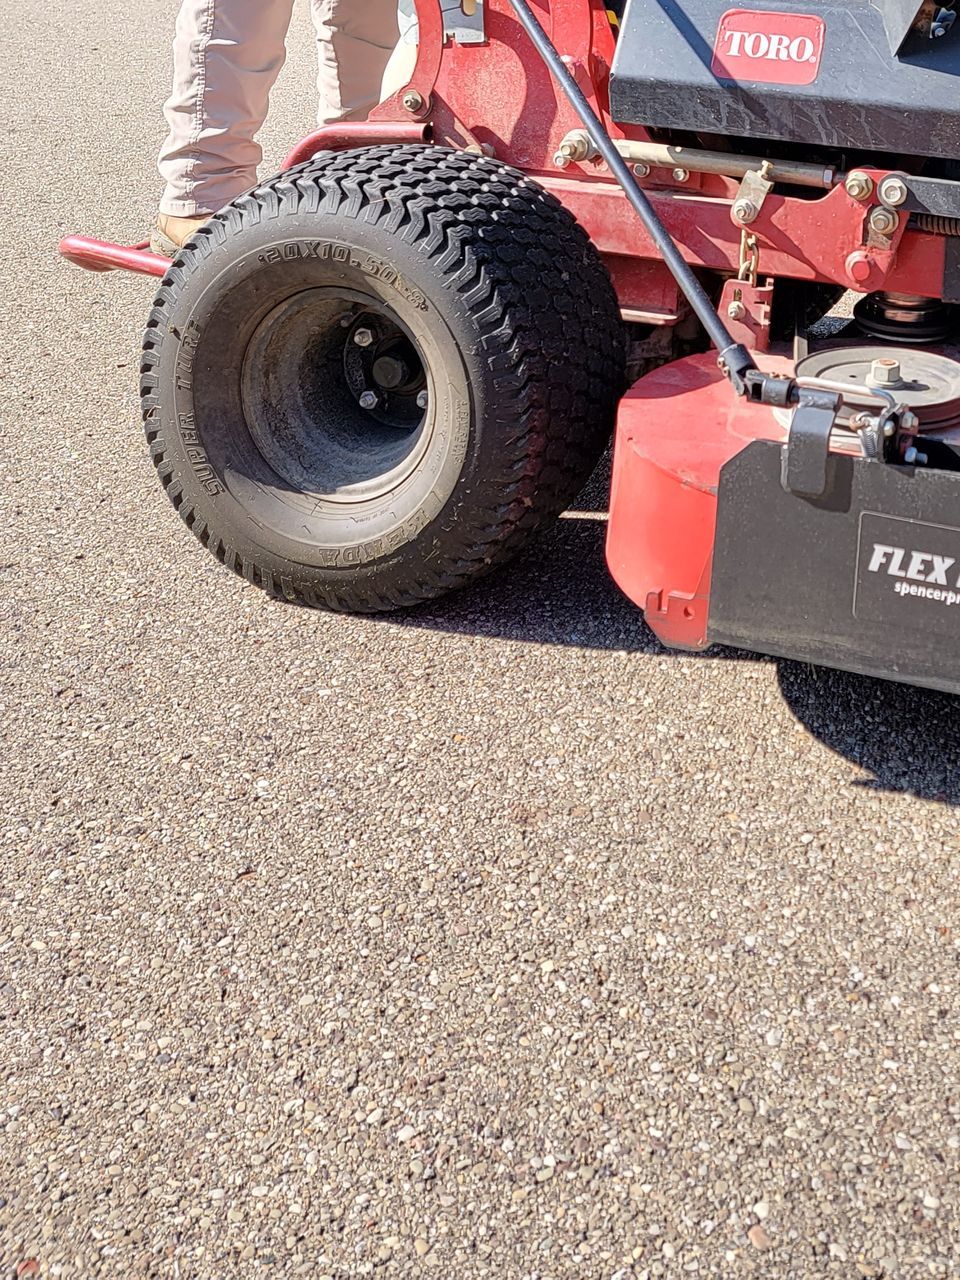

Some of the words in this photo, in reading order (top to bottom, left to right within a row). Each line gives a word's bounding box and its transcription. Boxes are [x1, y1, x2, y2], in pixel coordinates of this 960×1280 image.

[724, 31, 815, 63] TORO
[176, 320, 201, 390] TURF
[178, 412, 226, 496] SUPER
[318, 507, 431, 567] KENDA
[867, 542, 955, 586] FLEX
